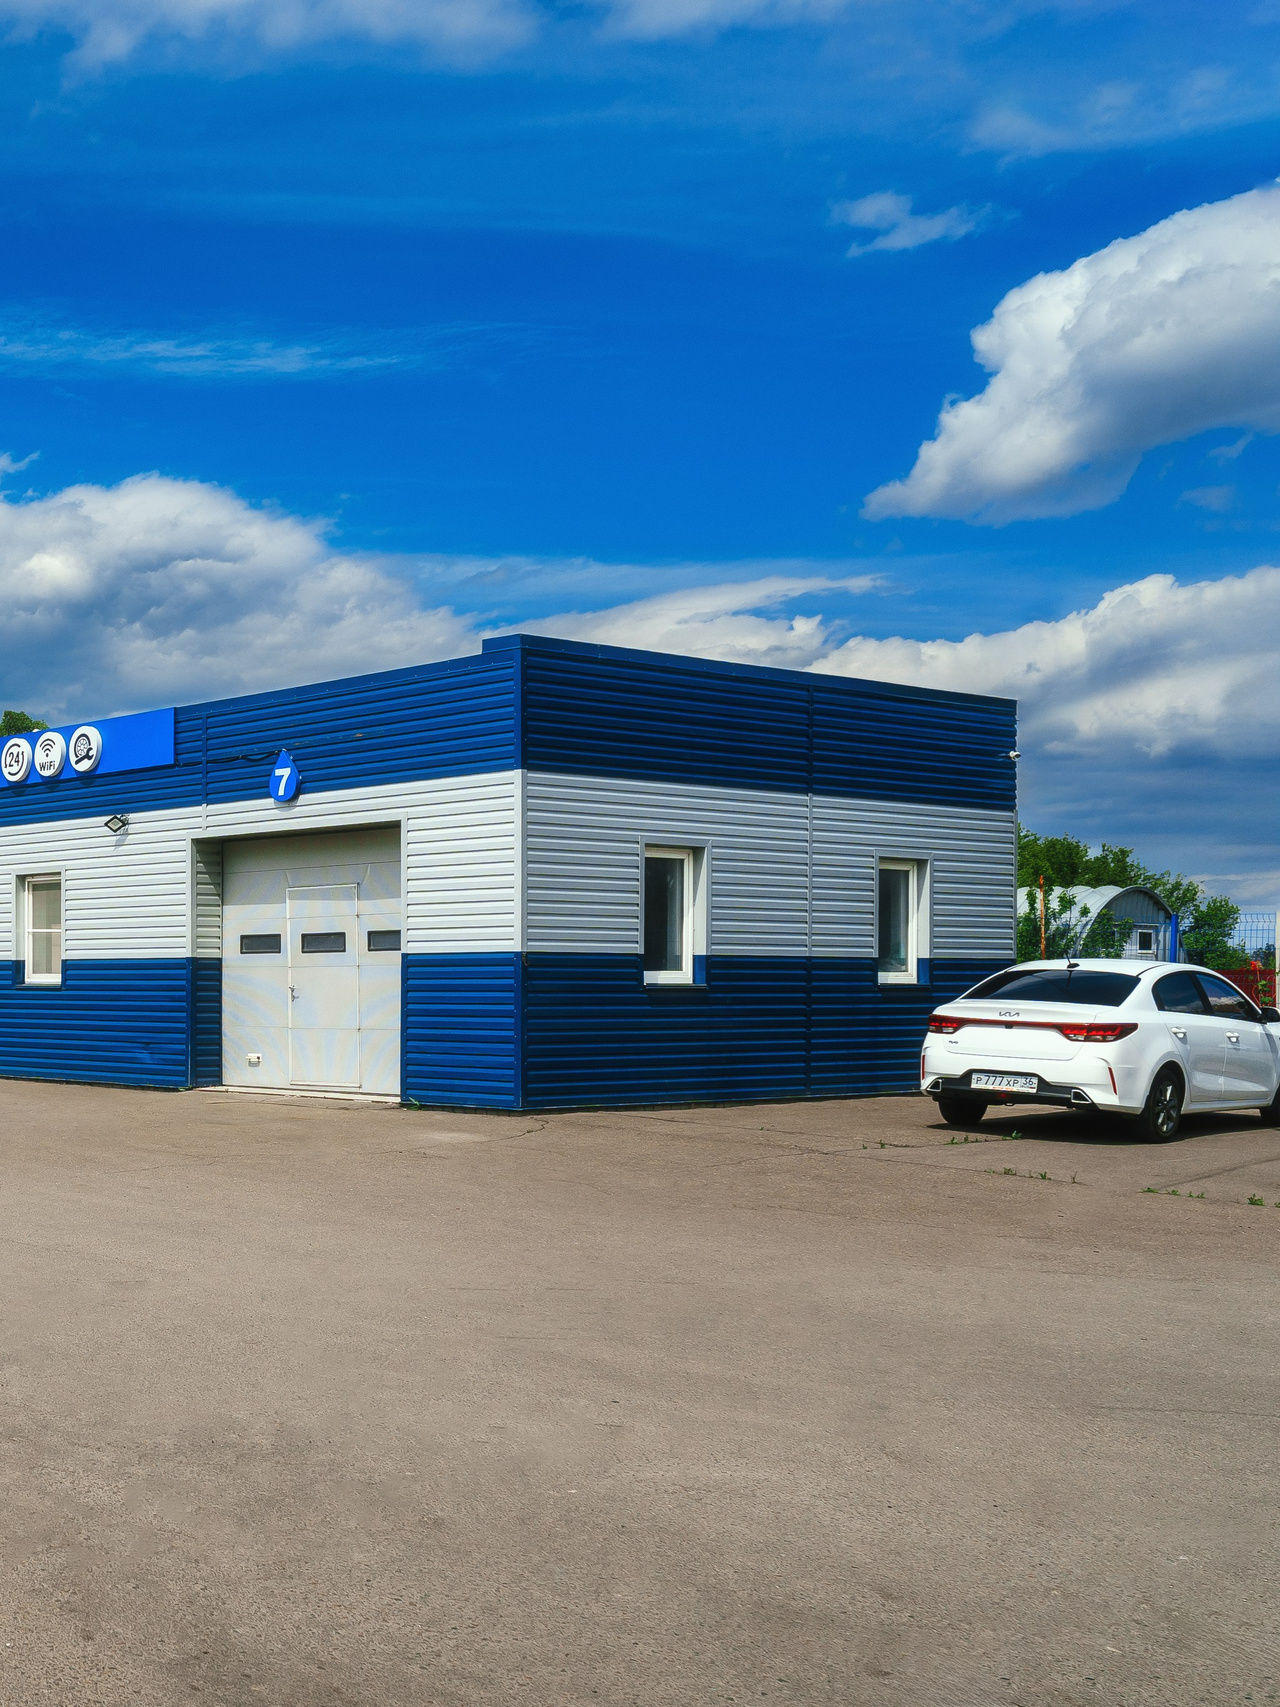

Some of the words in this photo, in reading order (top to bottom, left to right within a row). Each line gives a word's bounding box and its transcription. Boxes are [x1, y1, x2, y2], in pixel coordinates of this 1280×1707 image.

[8, 751, 20, 768] 24
[38, 760, 56, 772] WiFi
[275, 767, 291, 796] 7
[1022, 1078, 1034, 1086] 36
